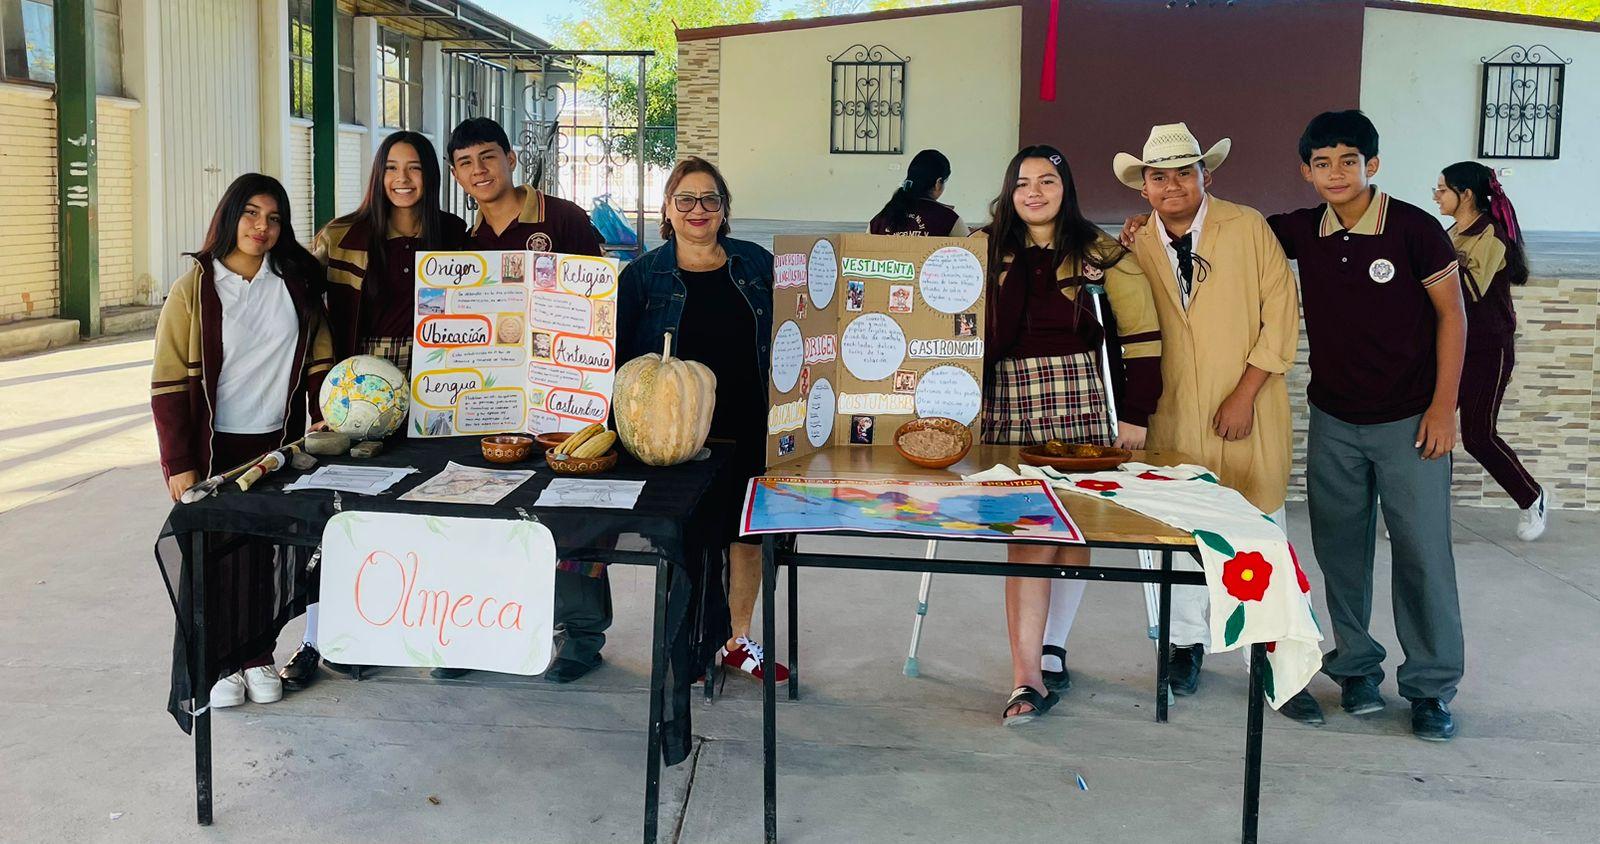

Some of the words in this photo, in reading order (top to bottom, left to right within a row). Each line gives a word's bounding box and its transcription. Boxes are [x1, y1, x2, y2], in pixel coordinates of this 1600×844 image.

[425, 257, 480, 285] Origen
[563, 261, 614, 297] Religión
[842, 258, 914, 275] VESTIMENTA
[422, 322, 486, 344] Ubicación
[804, 335, 838, 358] ORIGEN
[556, 339, 610, 367] Artesanía
[423, 375, 477, 405] Lengua
[354, 550, 523, 647] Olmeca
